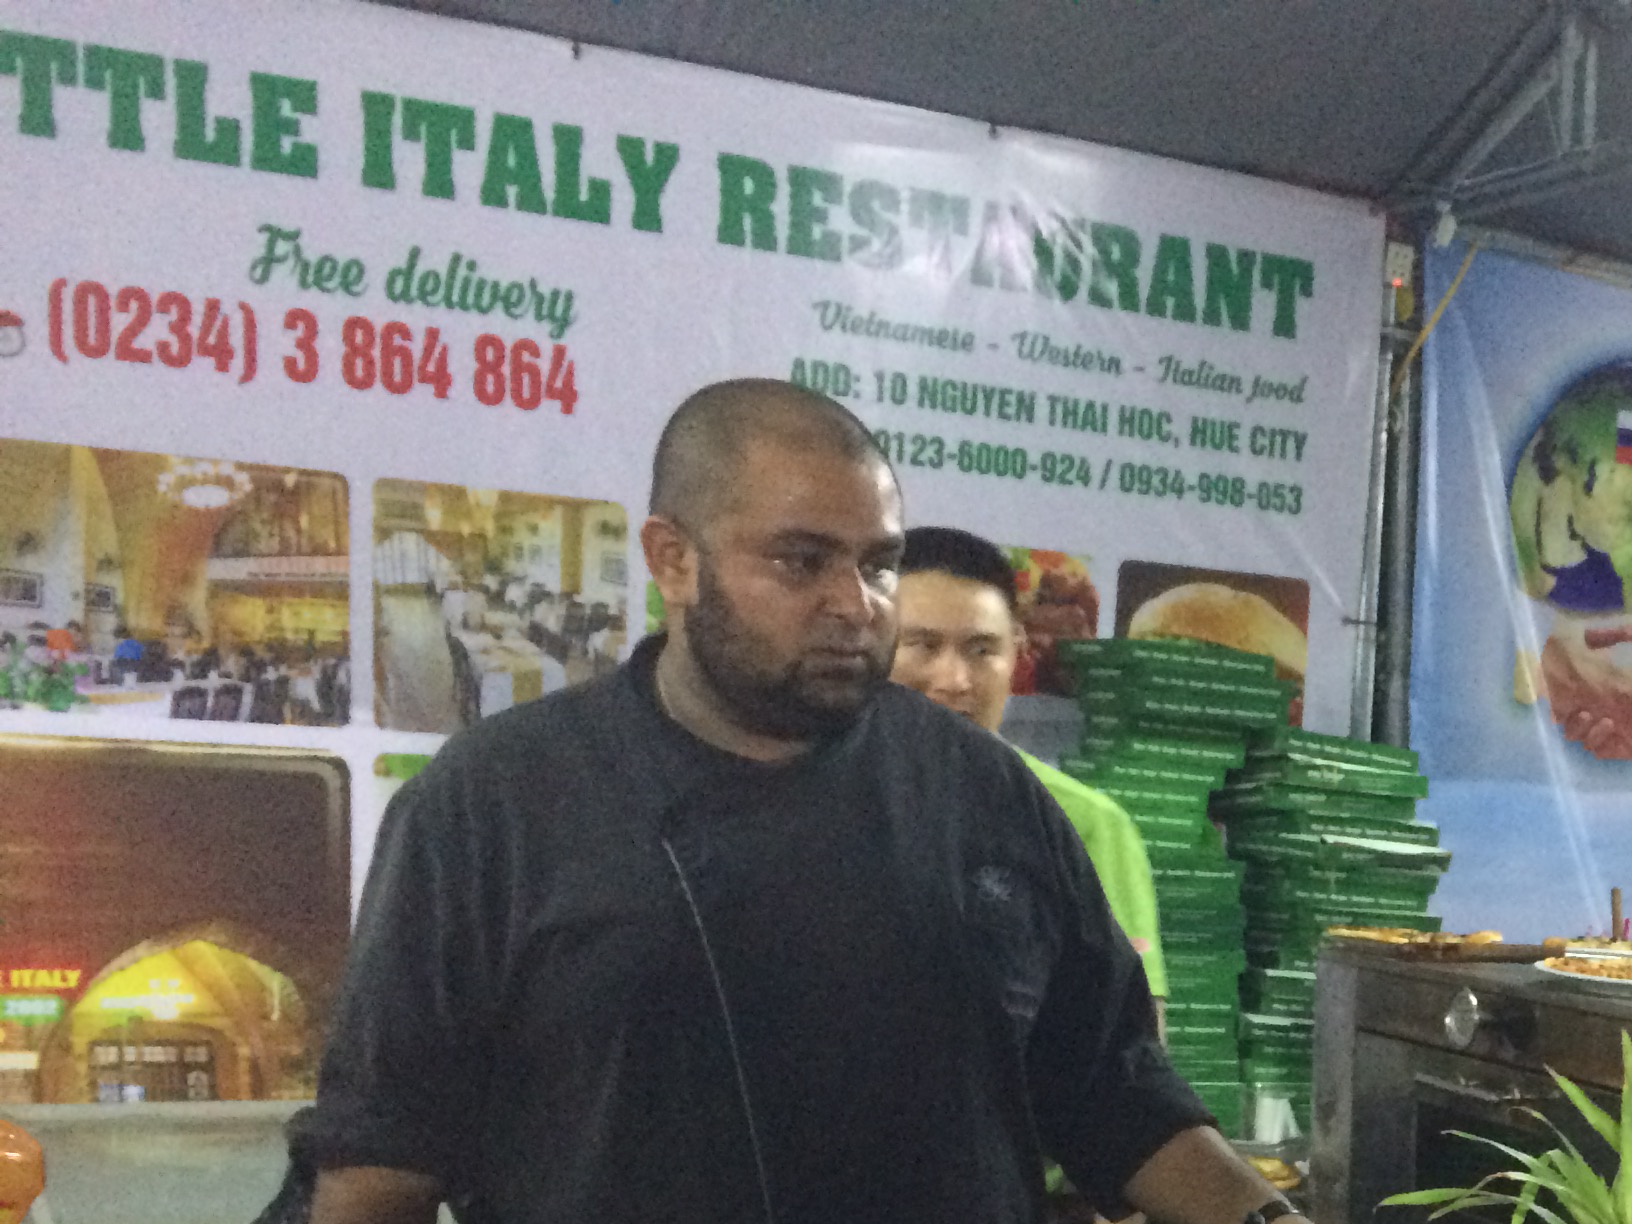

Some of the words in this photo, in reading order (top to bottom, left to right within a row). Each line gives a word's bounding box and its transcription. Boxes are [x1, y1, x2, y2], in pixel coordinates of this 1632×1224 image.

[0, 29, 318, 179] TTLE
[360, 90, 680, 233] ITALY
[716, 151, 1315, 339] RESTAURANT
[249, 223, 367, 296] Free
[385, 245, 576, 339] delivery
[48, 278, 258, 384] (0234)
[283, 308, 319, 383] 3
[341, 316, 452, 399] 864
[473, 333, 578, 415] 864
[812, 300, 975, 351] Vietnamese
[1011, 330, 1122, 376] Western
[1157, 354, 1243, 394] Italian
[1246, 374, 1309, 405] food
[790, 357, 861, 398] ADD:
[873, 369, 907, 405] 10
[917, 375, 1036, 423] NGUYEN
[1047, 394, 1109, 436] THAI
[1118, 404, 1179, 448] HOC,
[1189, 415, 1241, 454] HUE
[1249, 424, 1309, 462] CITY
[1119, 462, 1303, 515] 0934-998-053
[10, 969, 81, 989] ITALY
